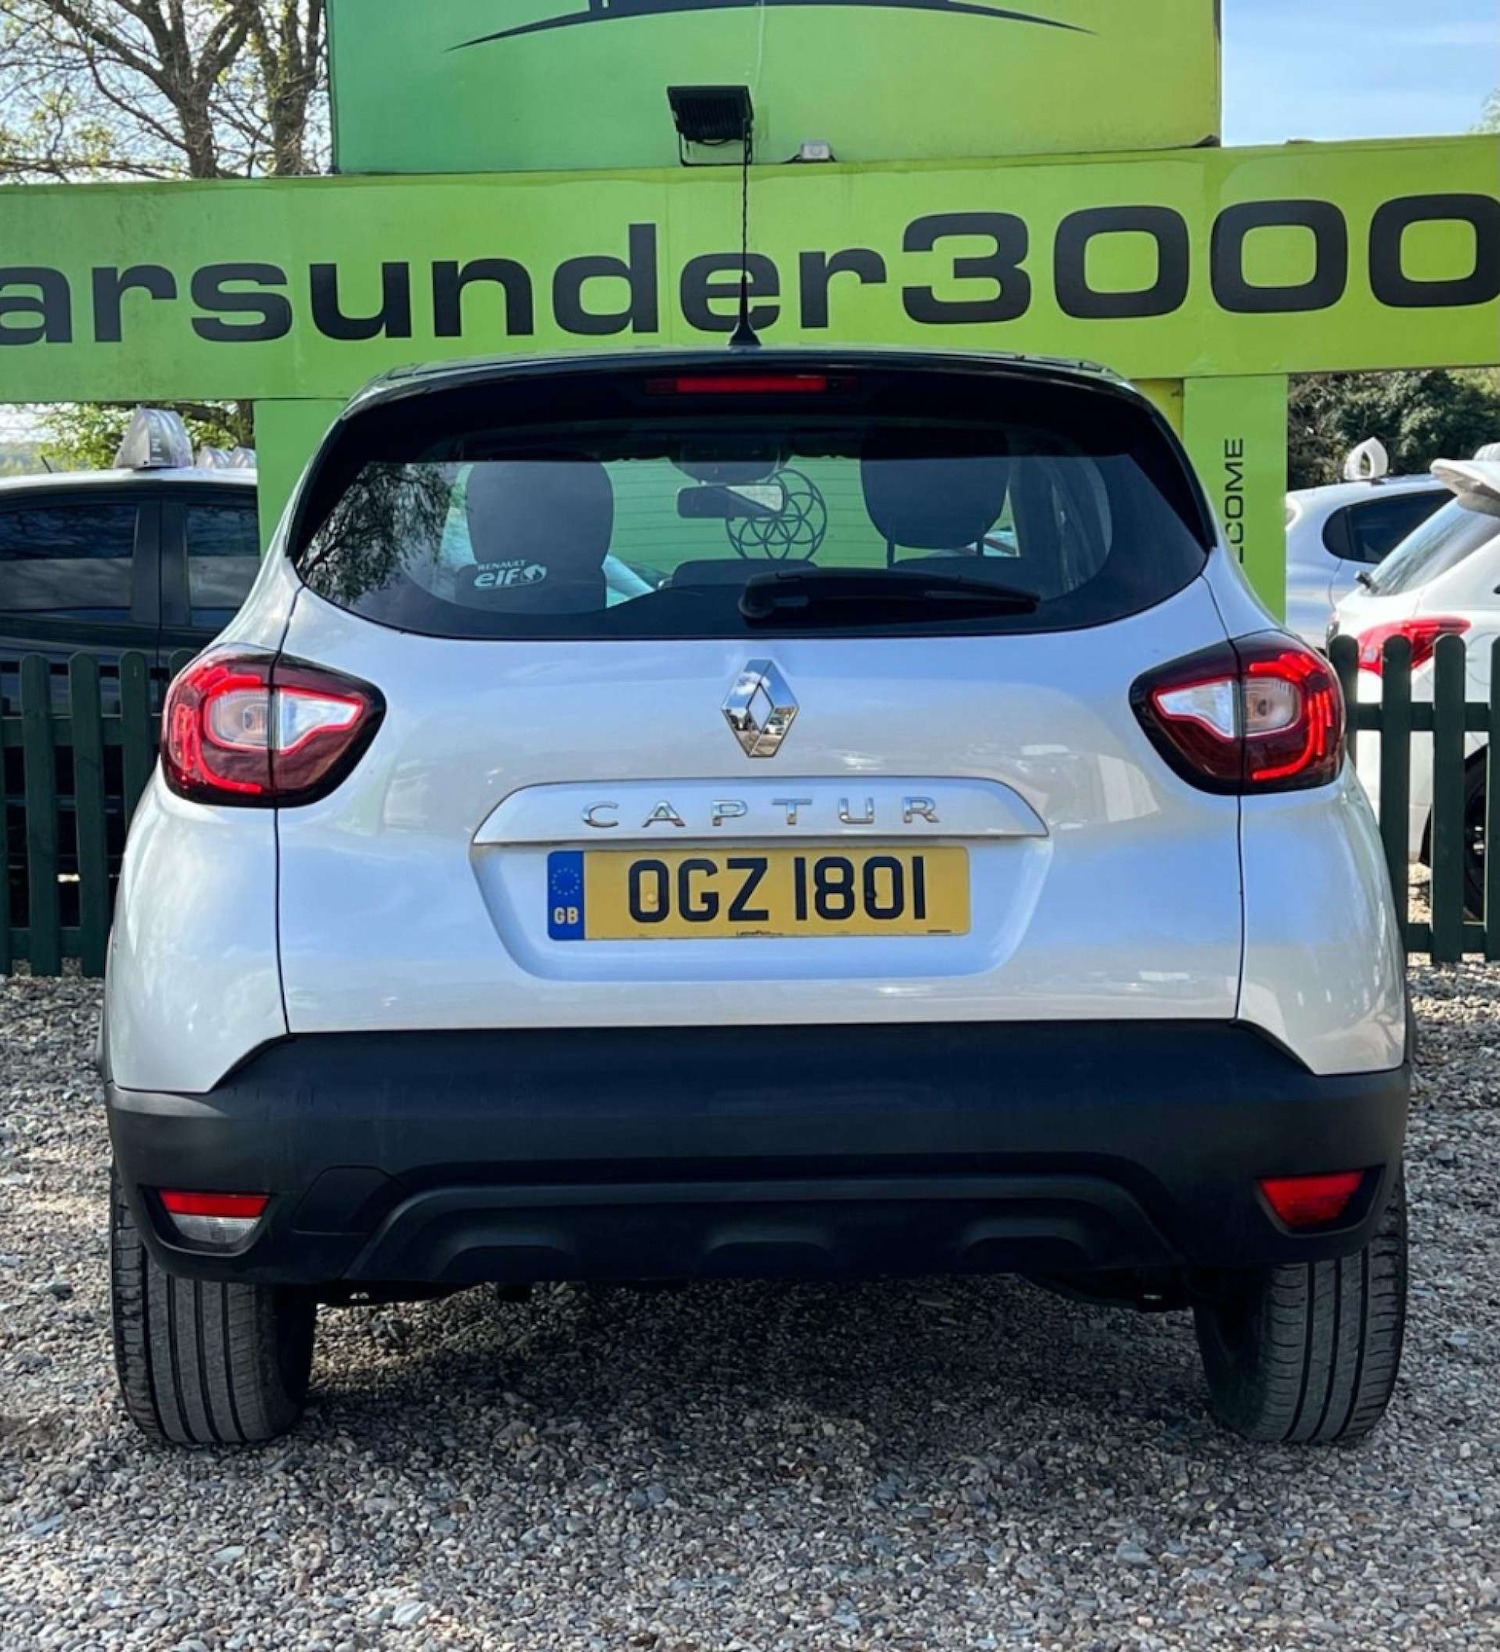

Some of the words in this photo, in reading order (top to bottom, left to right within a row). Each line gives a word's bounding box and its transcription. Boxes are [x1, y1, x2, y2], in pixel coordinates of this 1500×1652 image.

[477, 559, 526, 572] RENAULT
[474, 568, 520, 587] elf
[581, 796, 940, 828] CAPTUR
[628, 857, 769, 923] OGZ
[794, 855, 926, 921] 1801
[554, 906, 579, 925] GB
